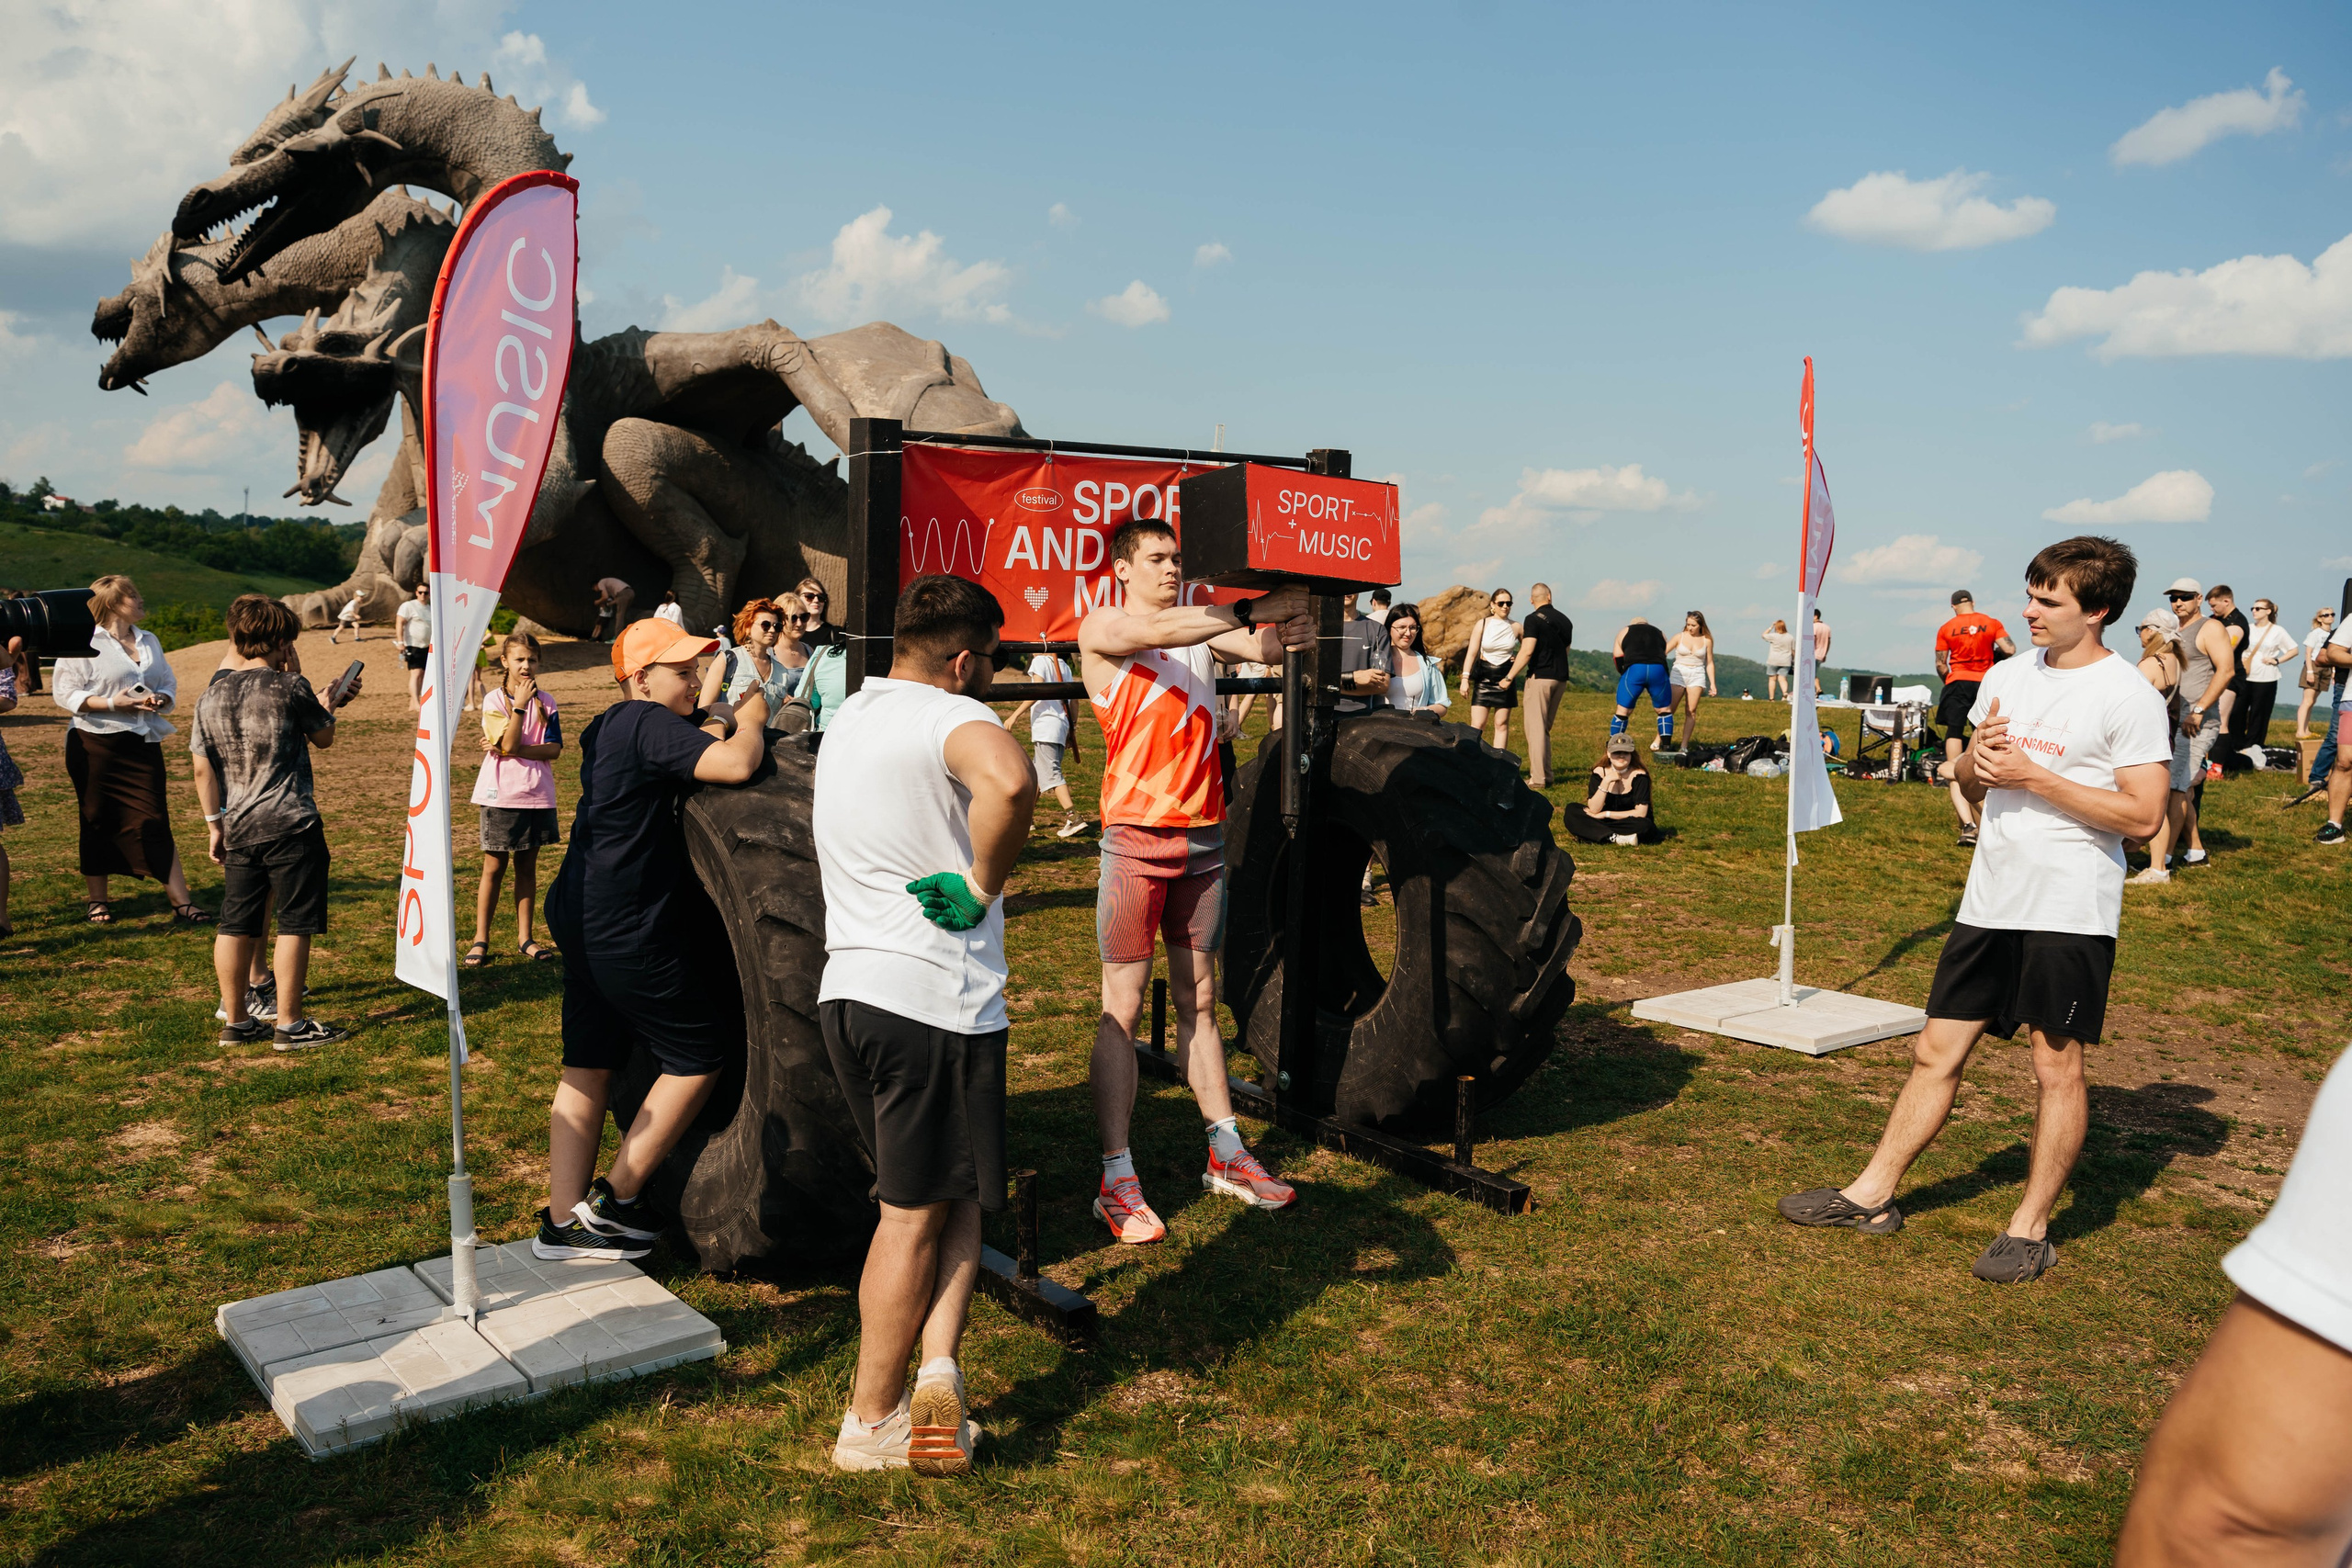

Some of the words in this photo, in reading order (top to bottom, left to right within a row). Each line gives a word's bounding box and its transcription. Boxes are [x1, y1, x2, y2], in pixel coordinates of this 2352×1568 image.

[1022, 493, 1057, 505] festival
[1073, 480, 1181, 525] SPOR
[1277, 490, 1354, 523] SPORT
[1004, 525, 1104, 571] AND
[1298, 529, 1373, 561] MUSIC
[1073, 576, 1215, 618] MIC
[2002, 733, 2065, 757] RONGMEN
[399, 643, 434, 947] SPO
